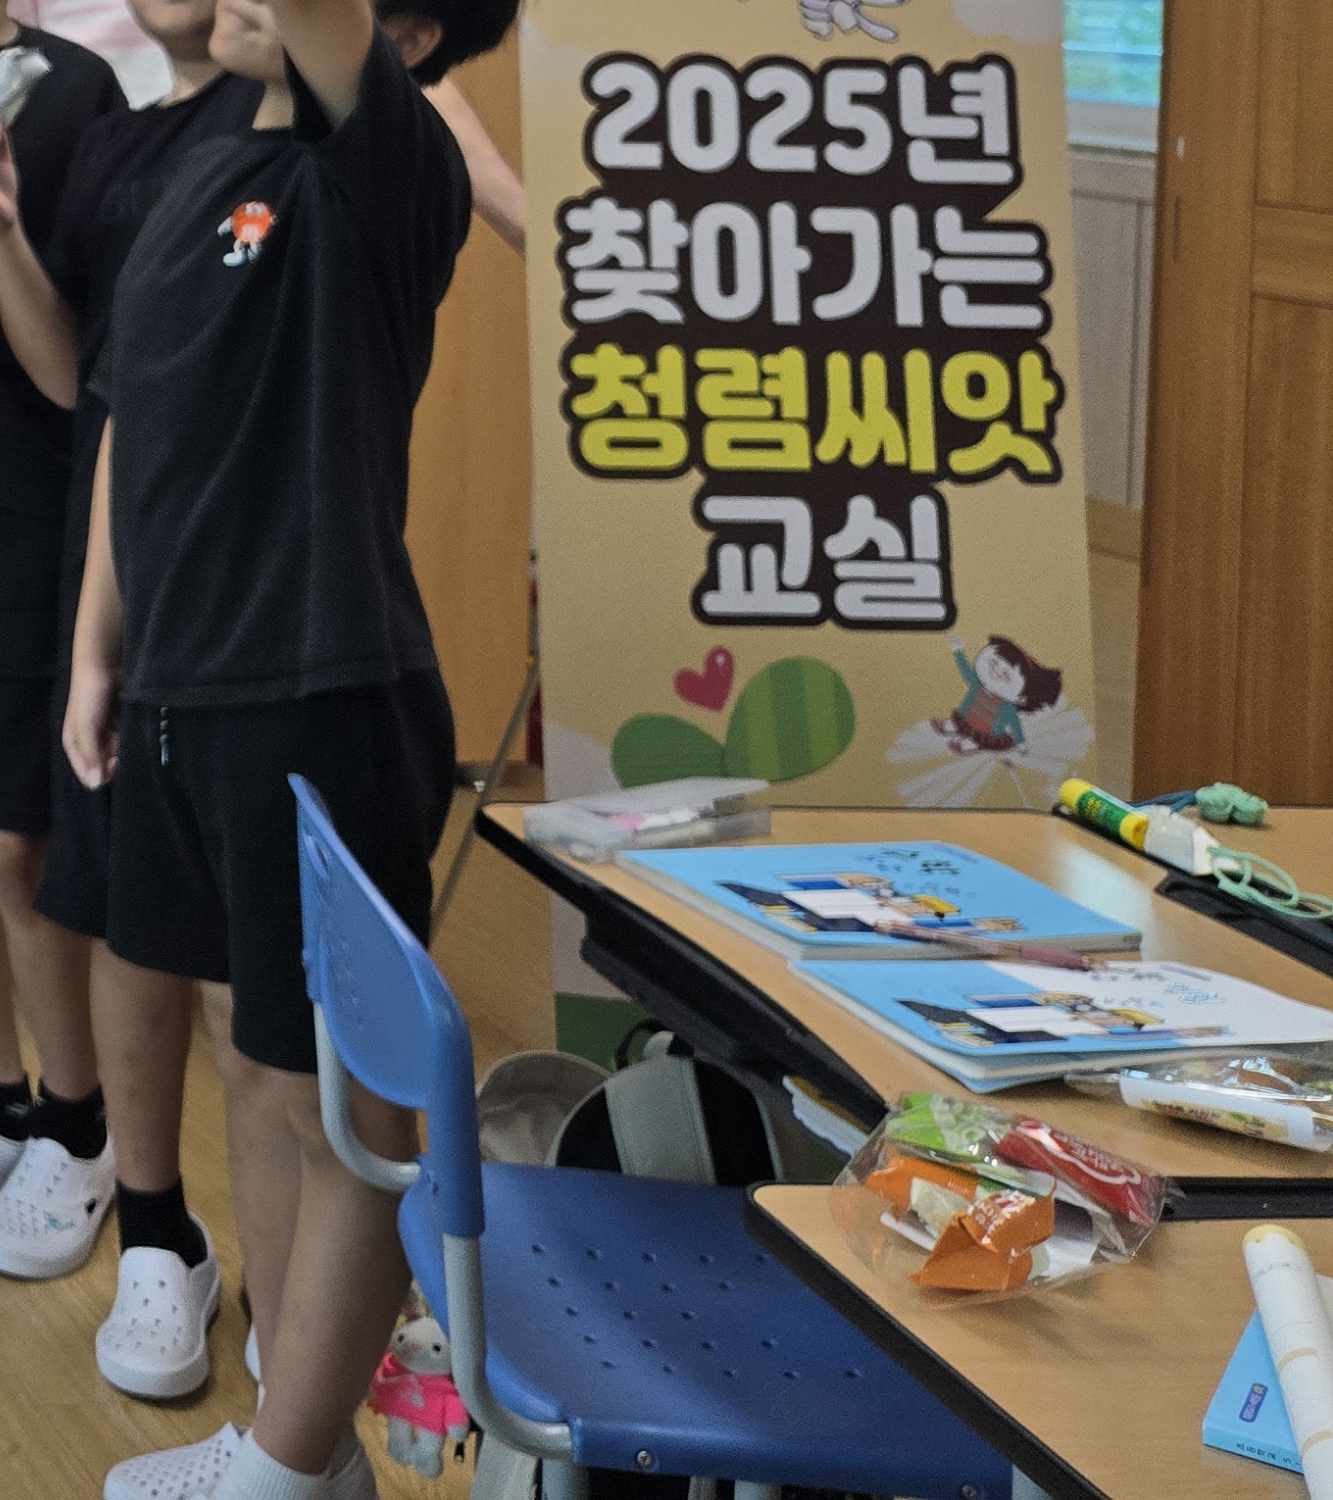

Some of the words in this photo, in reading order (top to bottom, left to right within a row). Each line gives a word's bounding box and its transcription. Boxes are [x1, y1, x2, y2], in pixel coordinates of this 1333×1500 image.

[586, 58, 1018, 187] 2025년
[564, 198, 1047, 331] 찾아가는
[568, 343, 1059, 476] 청렴씨앗
[701, 493, 949, 622] 교실
